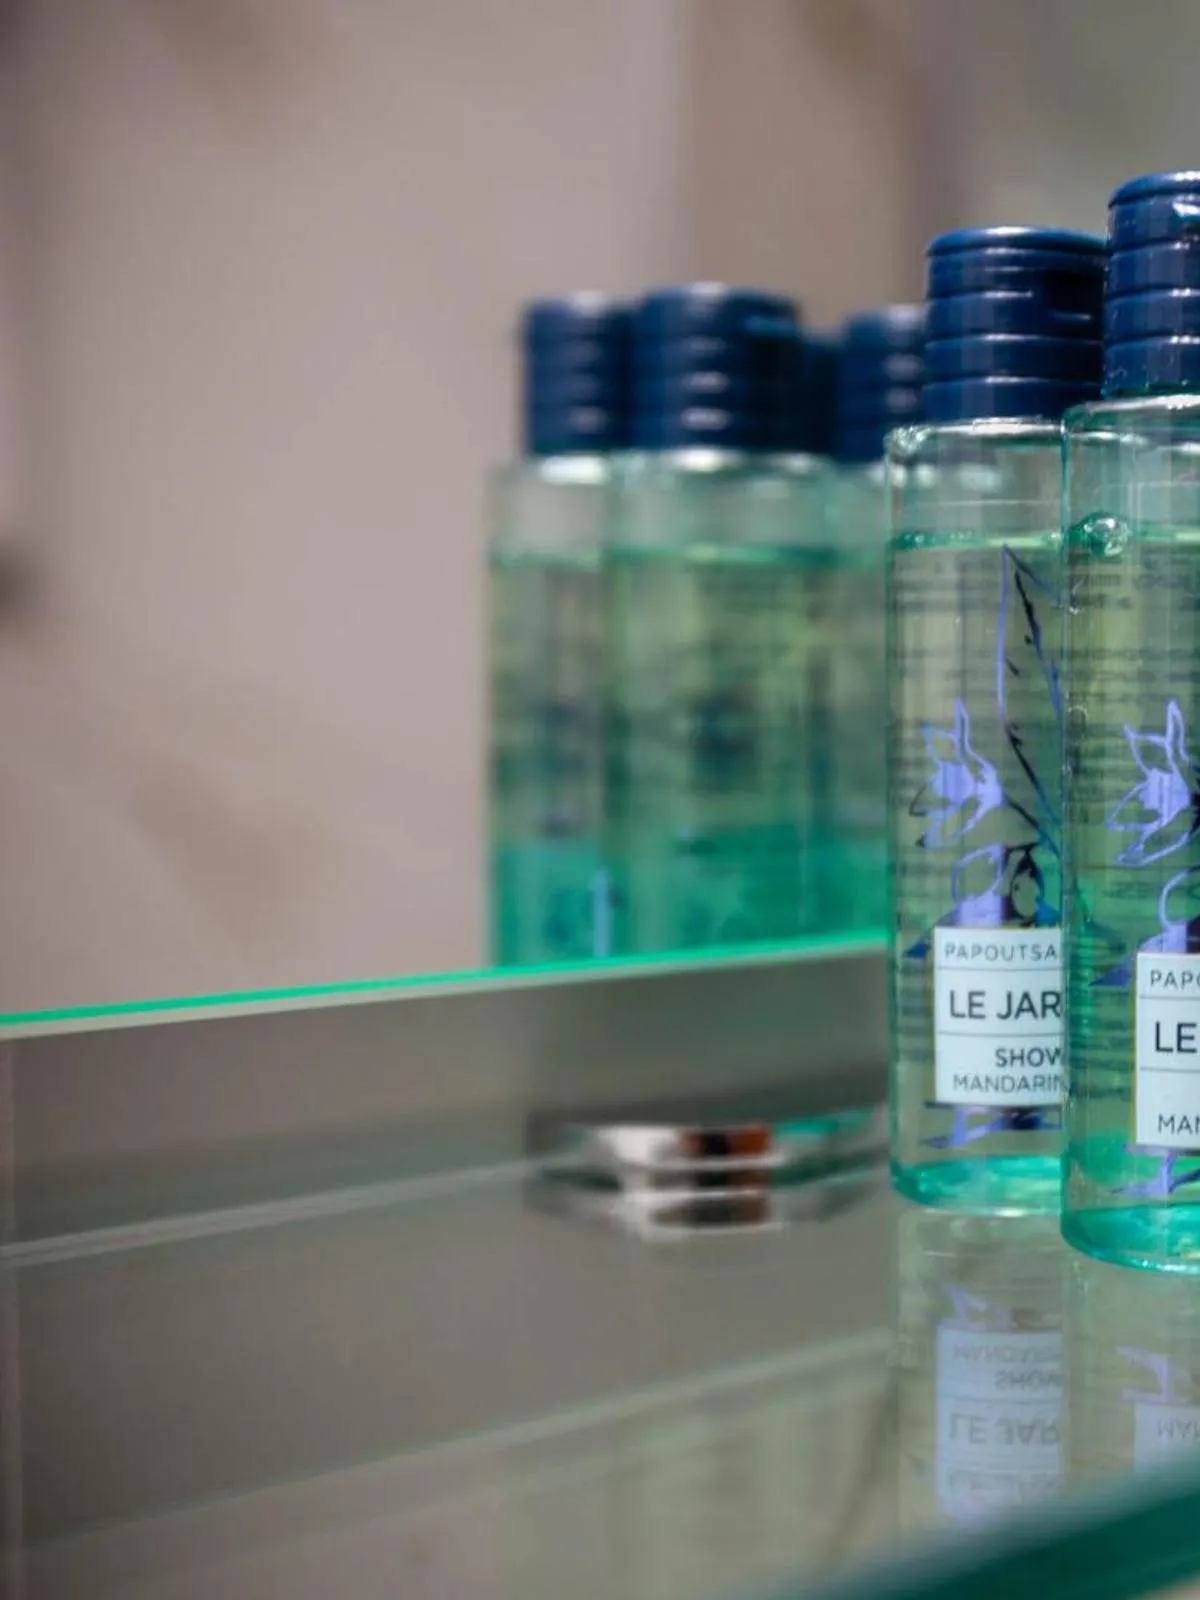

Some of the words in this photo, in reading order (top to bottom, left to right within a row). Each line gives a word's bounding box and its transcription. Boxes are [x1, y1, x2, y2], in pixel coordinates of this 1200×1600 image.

[945, 943, 1058, 961] PAPOUTSA
[950, 990, 986, 1019] LE
[997, 991, 1062, 1019] JAR
[1154, 1021, 1197, 1053] LE
